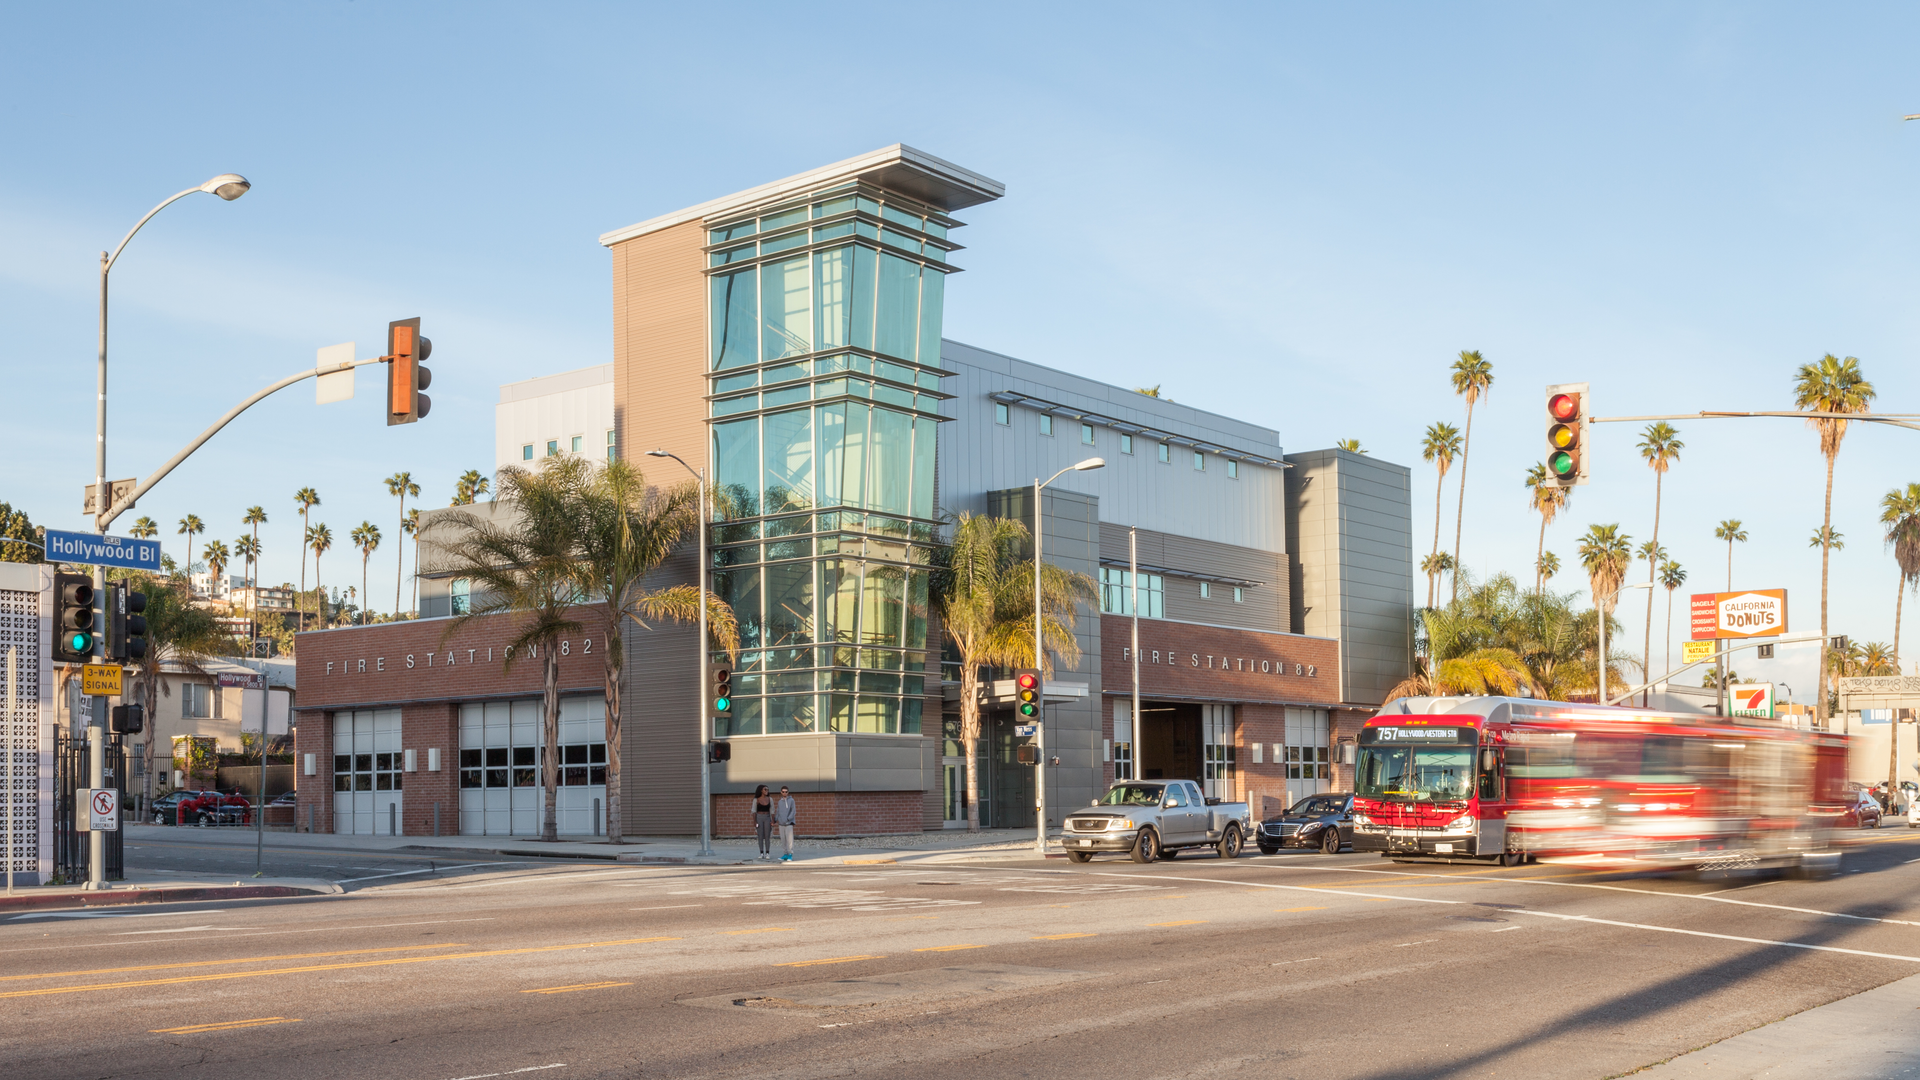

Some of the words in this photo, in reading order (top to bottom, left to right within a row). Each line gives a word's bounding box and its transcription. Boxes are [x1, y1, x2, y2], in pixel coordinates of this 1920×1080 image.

[53, 537, 134, 559] Hollywood
[140, 546, 155, 562] Bl
[1725, 601, 1775, 611] CALIFORNIA
[1727, 611, 1775, 627] DONUTS
[326, 658, 385, 675] FIRE
[406, 644, 537, 668] STATION
[561, 639, 592, 655] 82
[1123, 648, 1175, 665] FIRE
[1191, 654, 1283, 674] STATION
[1295, 664, 1315, 677] 82
[87, 668, 117, 677] 3-WAY
[221, 673, 251, 683] Hollywood
[86, 681, 119, 690] SIGNAL
[1736, 688, 1765, 709] 7
[1377, 727, 1398, 740] 757
[1502, 730, 1516, 740] Metro
